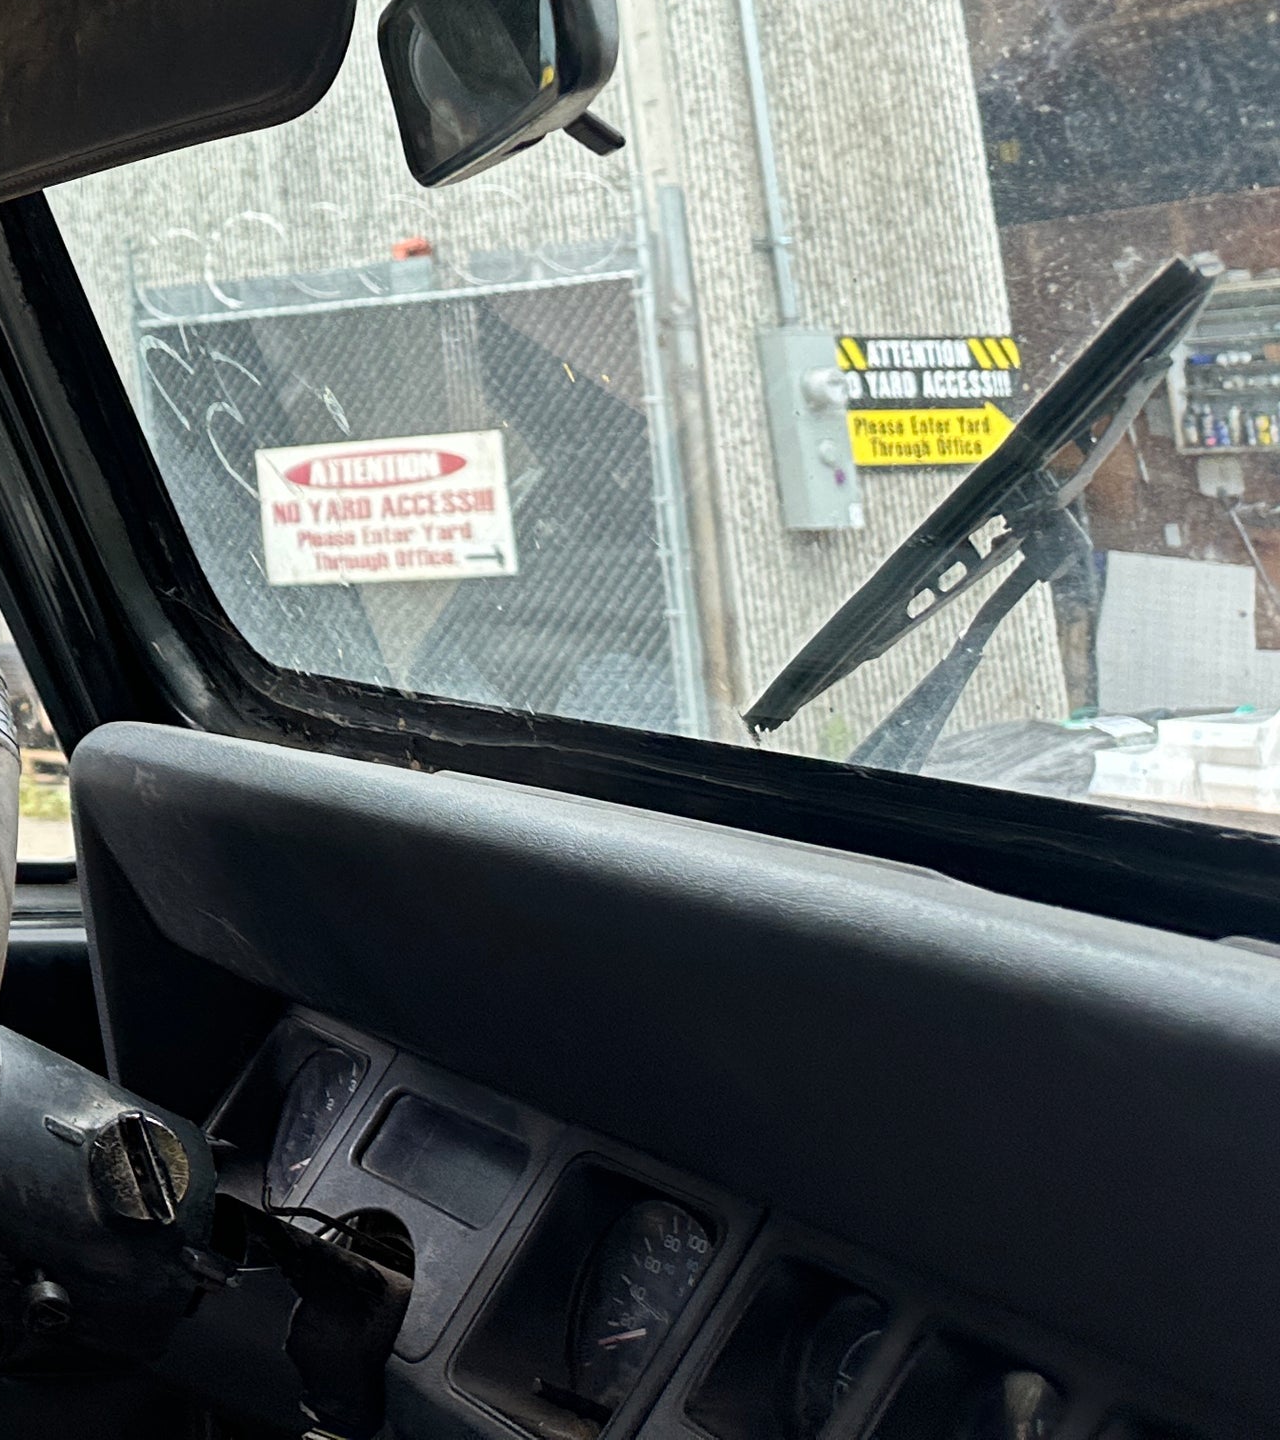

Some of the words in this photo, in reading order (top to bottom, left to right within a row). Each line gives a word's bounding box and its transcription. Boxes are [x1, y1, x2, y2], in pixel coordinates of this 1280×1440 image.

[866, 339, 971, 368] ATTENTION
[864, 371, 918, 399] YARD
[853, 416, 904, 436] Please
[910, 415, 951, 435] Enter
[956, 415, 991, 435] Yard
[871, 437, 931, 459] Through
[937, 438, 983, 456] Office
[309, 451, 440, 486] ATTENTION
[272, 500, 301, 524] NO
[308, 496, 372, 524] YARD
[297, 530, 356, 551] Please
[362, 525, 416, 546] Enter
[422, 521, 473, 542] Yard
[313, 552, 390, 573] Through
